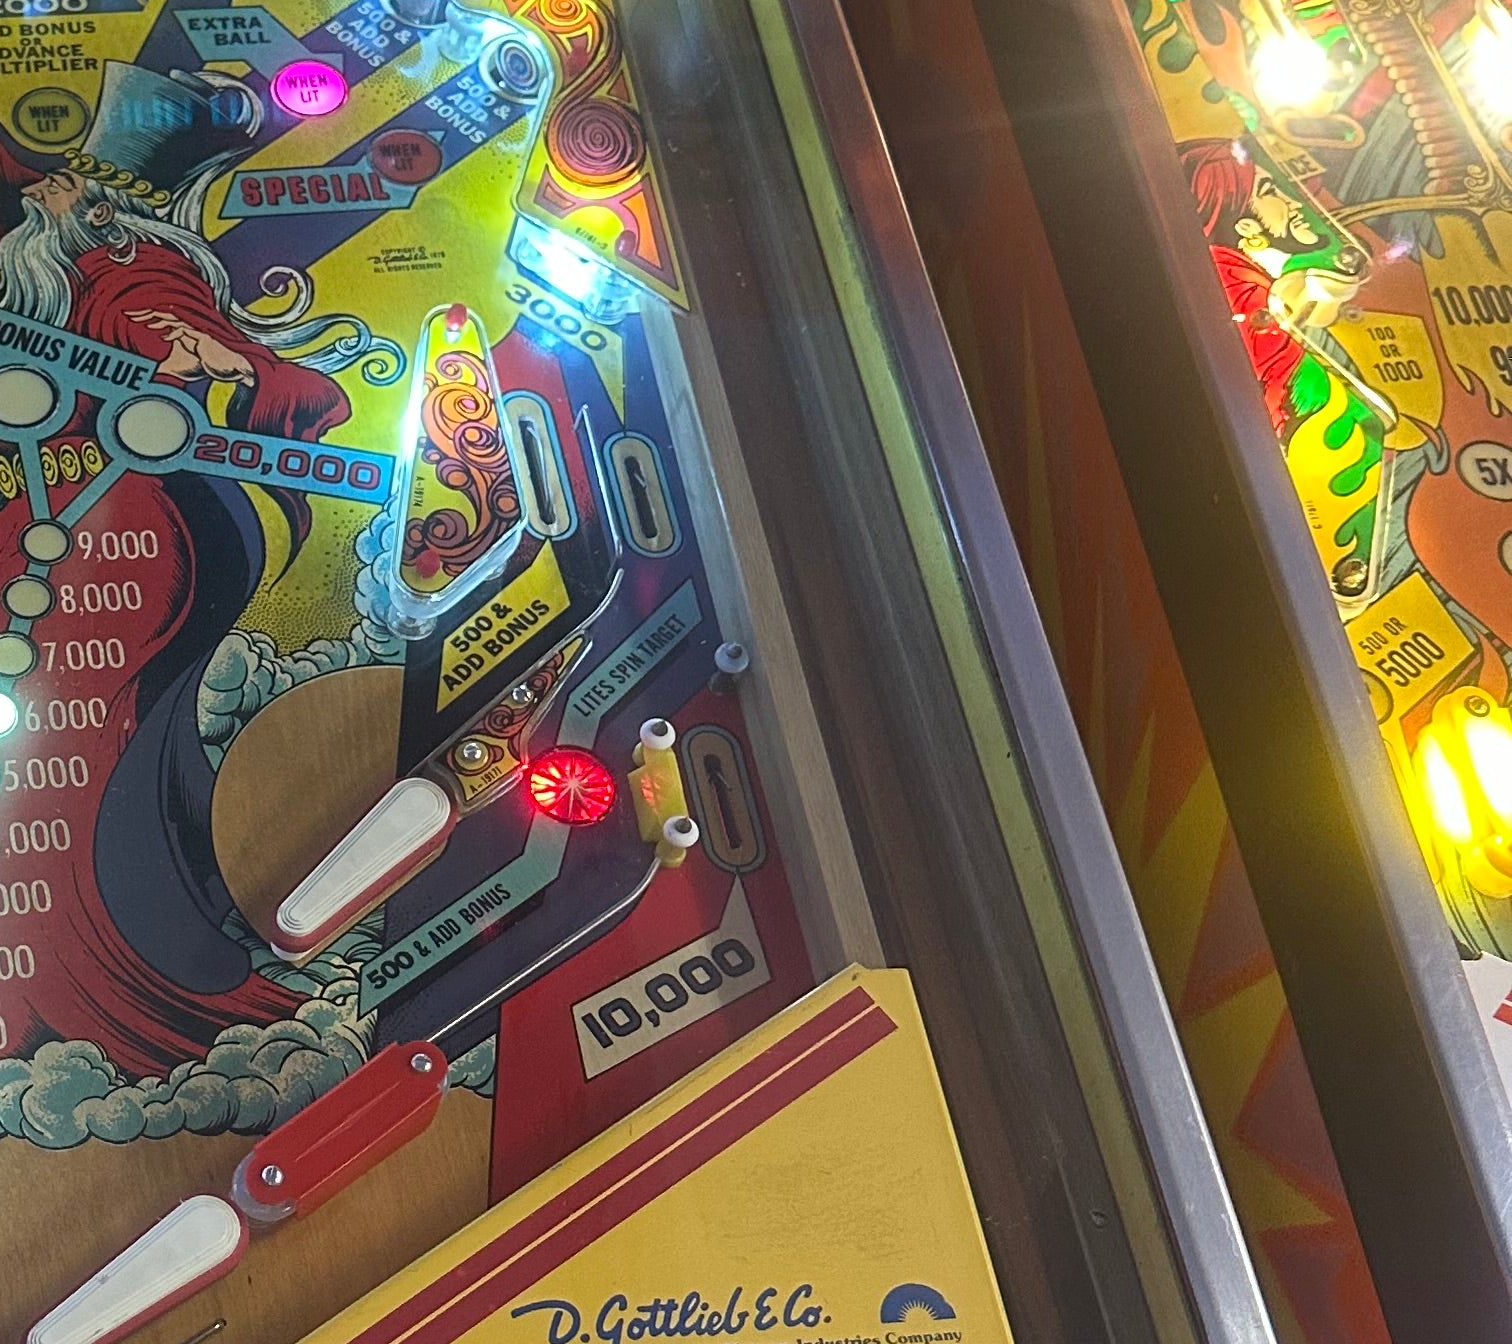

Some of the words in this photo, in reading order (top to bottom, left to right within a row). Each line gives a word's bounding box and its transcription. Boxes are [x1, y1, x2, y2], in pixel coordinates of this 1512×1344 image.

[19, 21, 96, 36] BONUS
[188, 16, 262, 32] EXTRA
[214, 31, 271, 46] BALL
[285, 73, 329, 89] WHEN
[299, 89, 320, 103] LIT
[455, 76, 496, 108] 500
[492, 104, 511, 121] &
[29, 105, 69, 119] WHEN
[425, 96, 487, 144] BONUS
[447, 91, 489, 123] ADD
[38, 120, 60, 134] LIT
[241, 173, 390, 208] SPECIAL
[504, 282, 608, 352] 3000
[1367, 326, 1396, 341] 100
[70, 344, 151, 393] VALUE
[1380, 345, 1400, 358] OR
[1373, 359, 1424, 382] 1000
[195, 433, 383, 493] 20,000
[76, 529, 159, 563] 9,000
[58, 580, 143, 616] 8,000
[449, 615, 495, 654] 500
[488, 600, 511, 622] &
[1357, 630, 1387, 656] 500
[1385, 616, 1409, 639] OR
[39, 638, 126, 673] 7,000
[440, 639, 497, 694] ADD
[485, 598, 551, 659] BONUS
[1375, 630, 1446, 688] 5000
[572, 675, 616, 719] LITES
[610, 645, 643, 685] SPIN
[637, 613, 685, 663] TARGET
[24, 696, 107, 733] 6,000
[1, 755, 89, 793] 5,000
[365, 950, 415, 991] 500
[415, 937, 432, 958] &
[430, 913, 462, 949] ADD
[460, 882, 513, 929] BONUS
[580, 937, 758, 1050] 10,000
[778, 1282, 833, 1328] Co.
